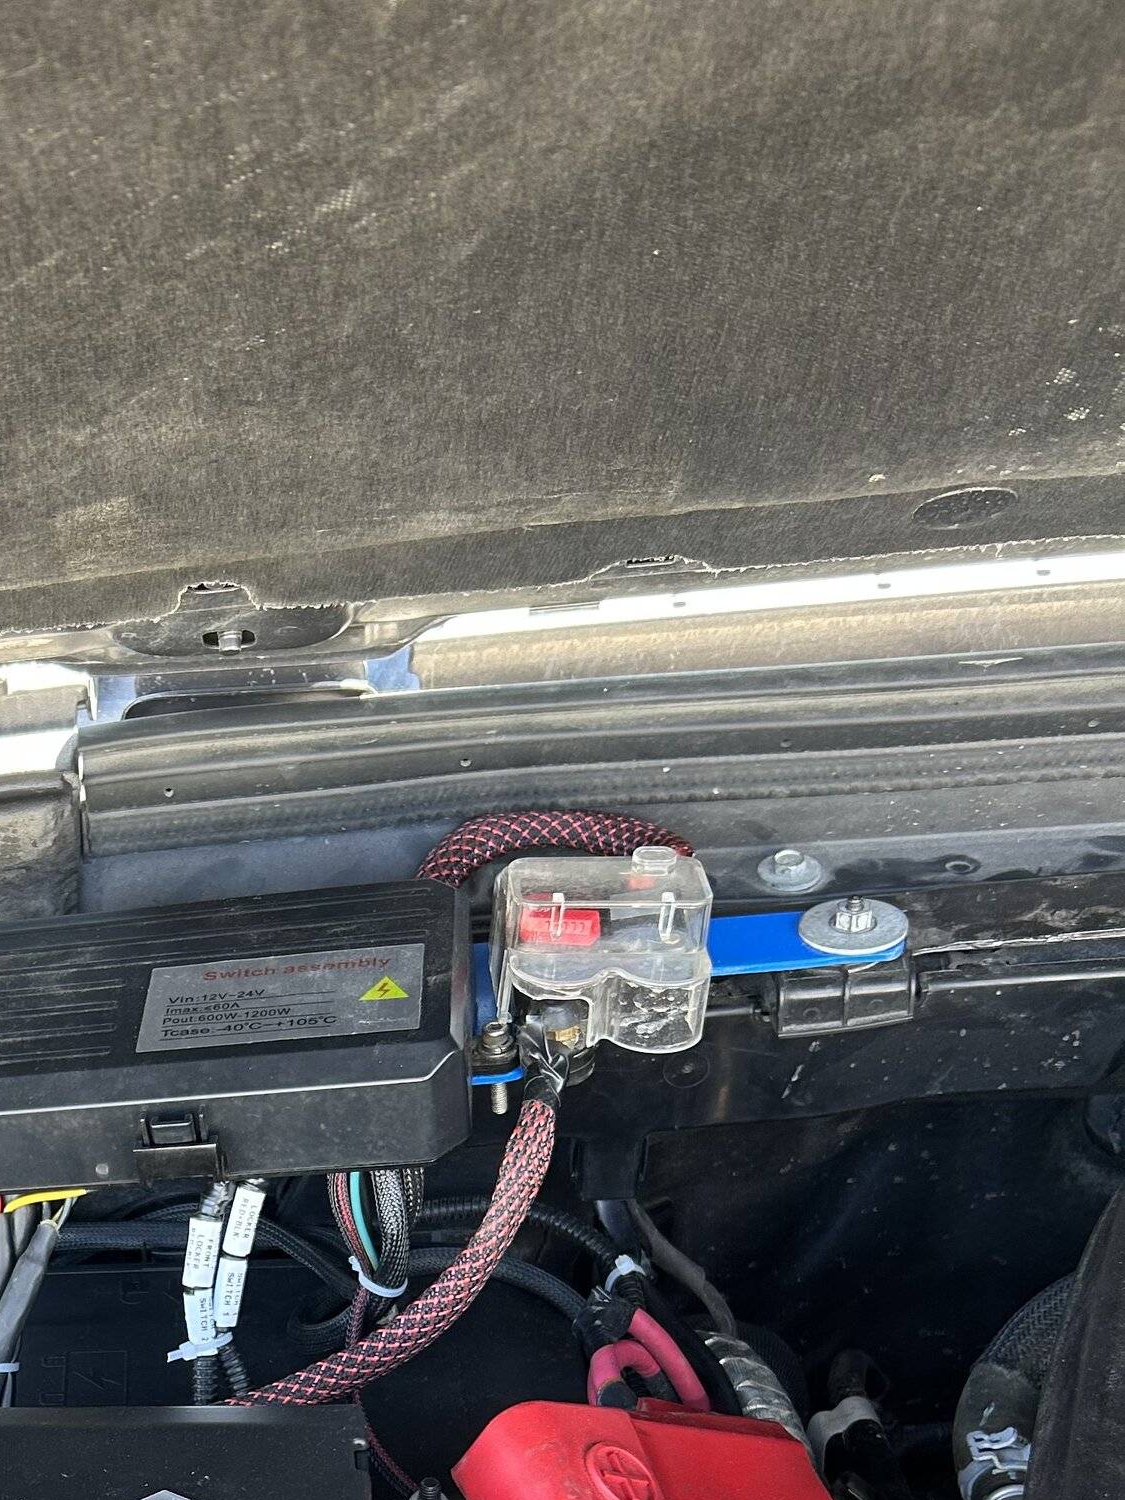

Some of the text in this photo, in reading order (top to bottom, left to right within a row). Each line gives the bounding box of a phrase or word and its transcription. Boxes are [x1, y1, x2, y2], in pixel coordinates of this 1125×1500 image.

[203, 956, 392, 981] Switch assembly
[244, 1205, 257, 1238] LOCKER
[194, 1234, 203, 1269] LOCKER
[204, 1239, 213, 1267] FRONT
[225, 1272, 233, 1306] SWITCH
